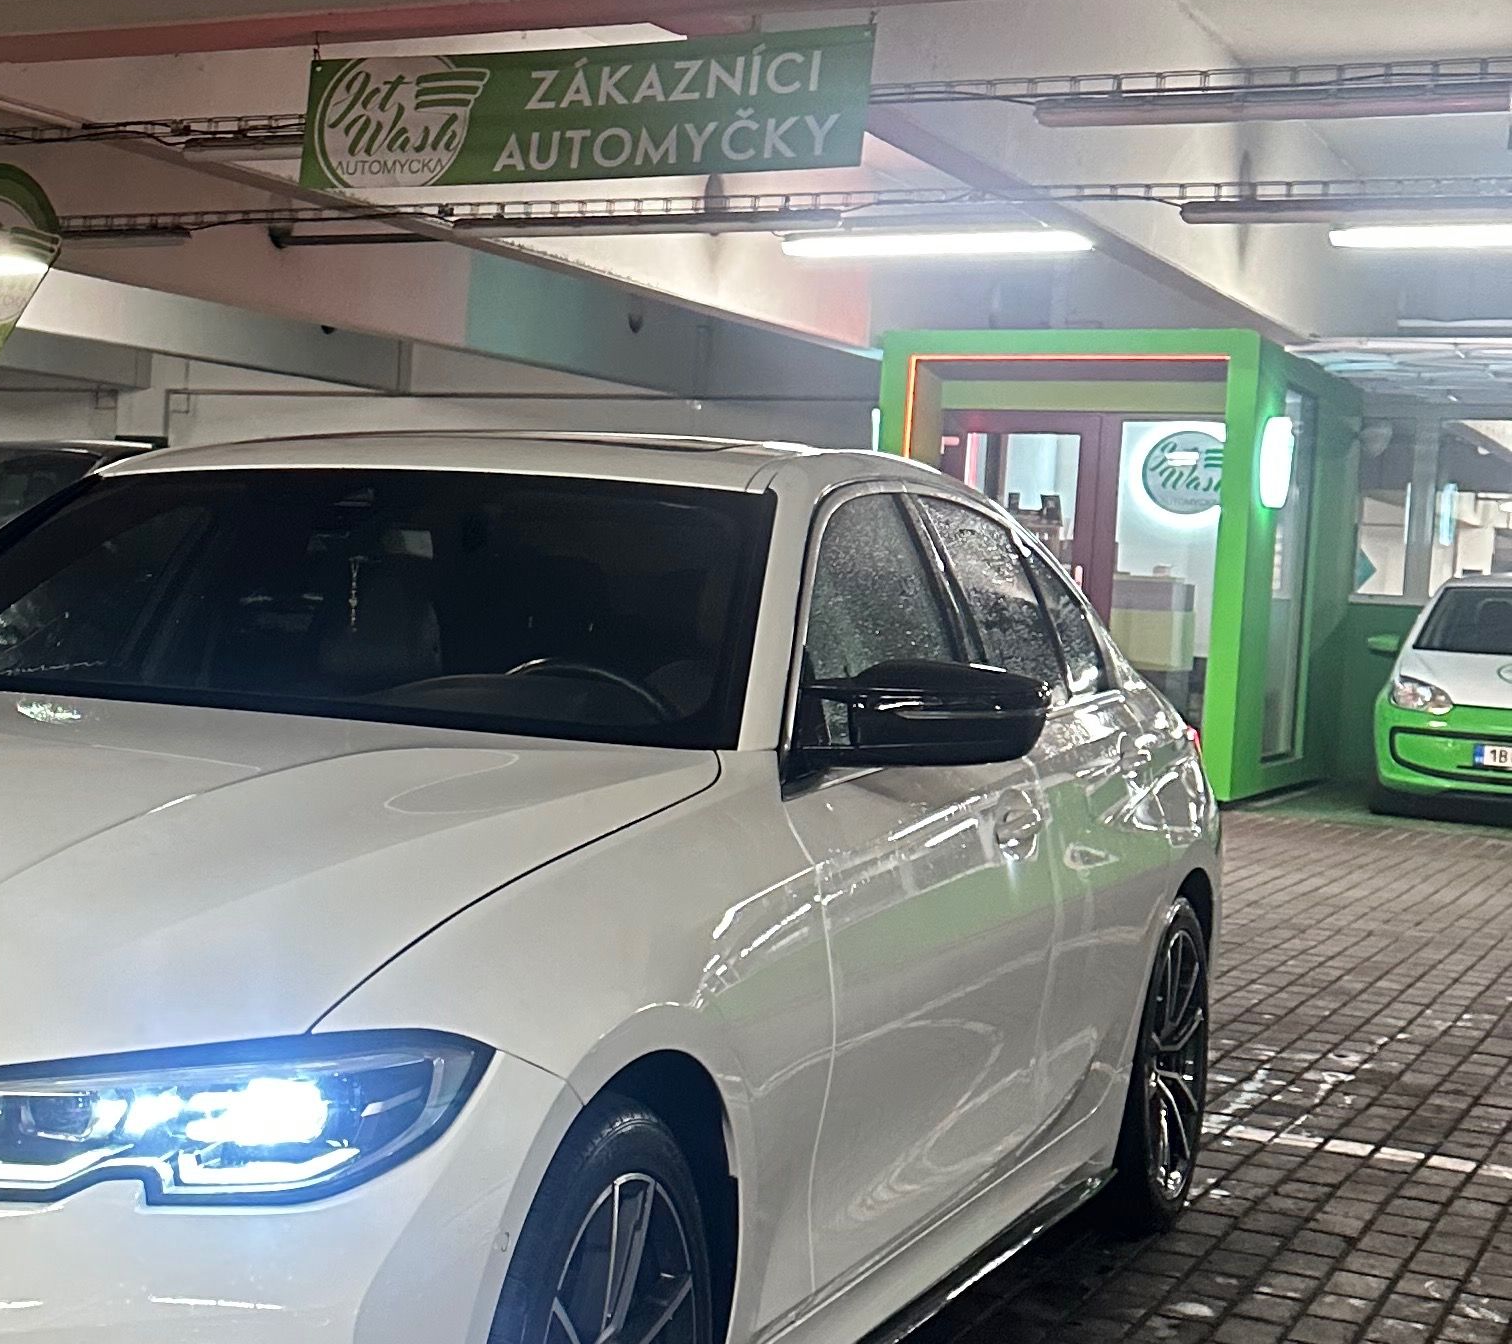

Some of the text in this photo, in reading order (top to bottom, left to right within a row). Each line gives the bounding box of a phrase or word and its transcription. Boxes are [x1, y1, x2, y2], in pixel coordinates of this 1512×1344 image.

[328, 65, 413, 129] Jet
[524, 43, 821, 111] ZÁKAZNÍCI
[344, 102, 460, 157] Wash
[492, 107, 840, 174] AUTOMYČKY
[1490, 749, 1512, 764] 1B
